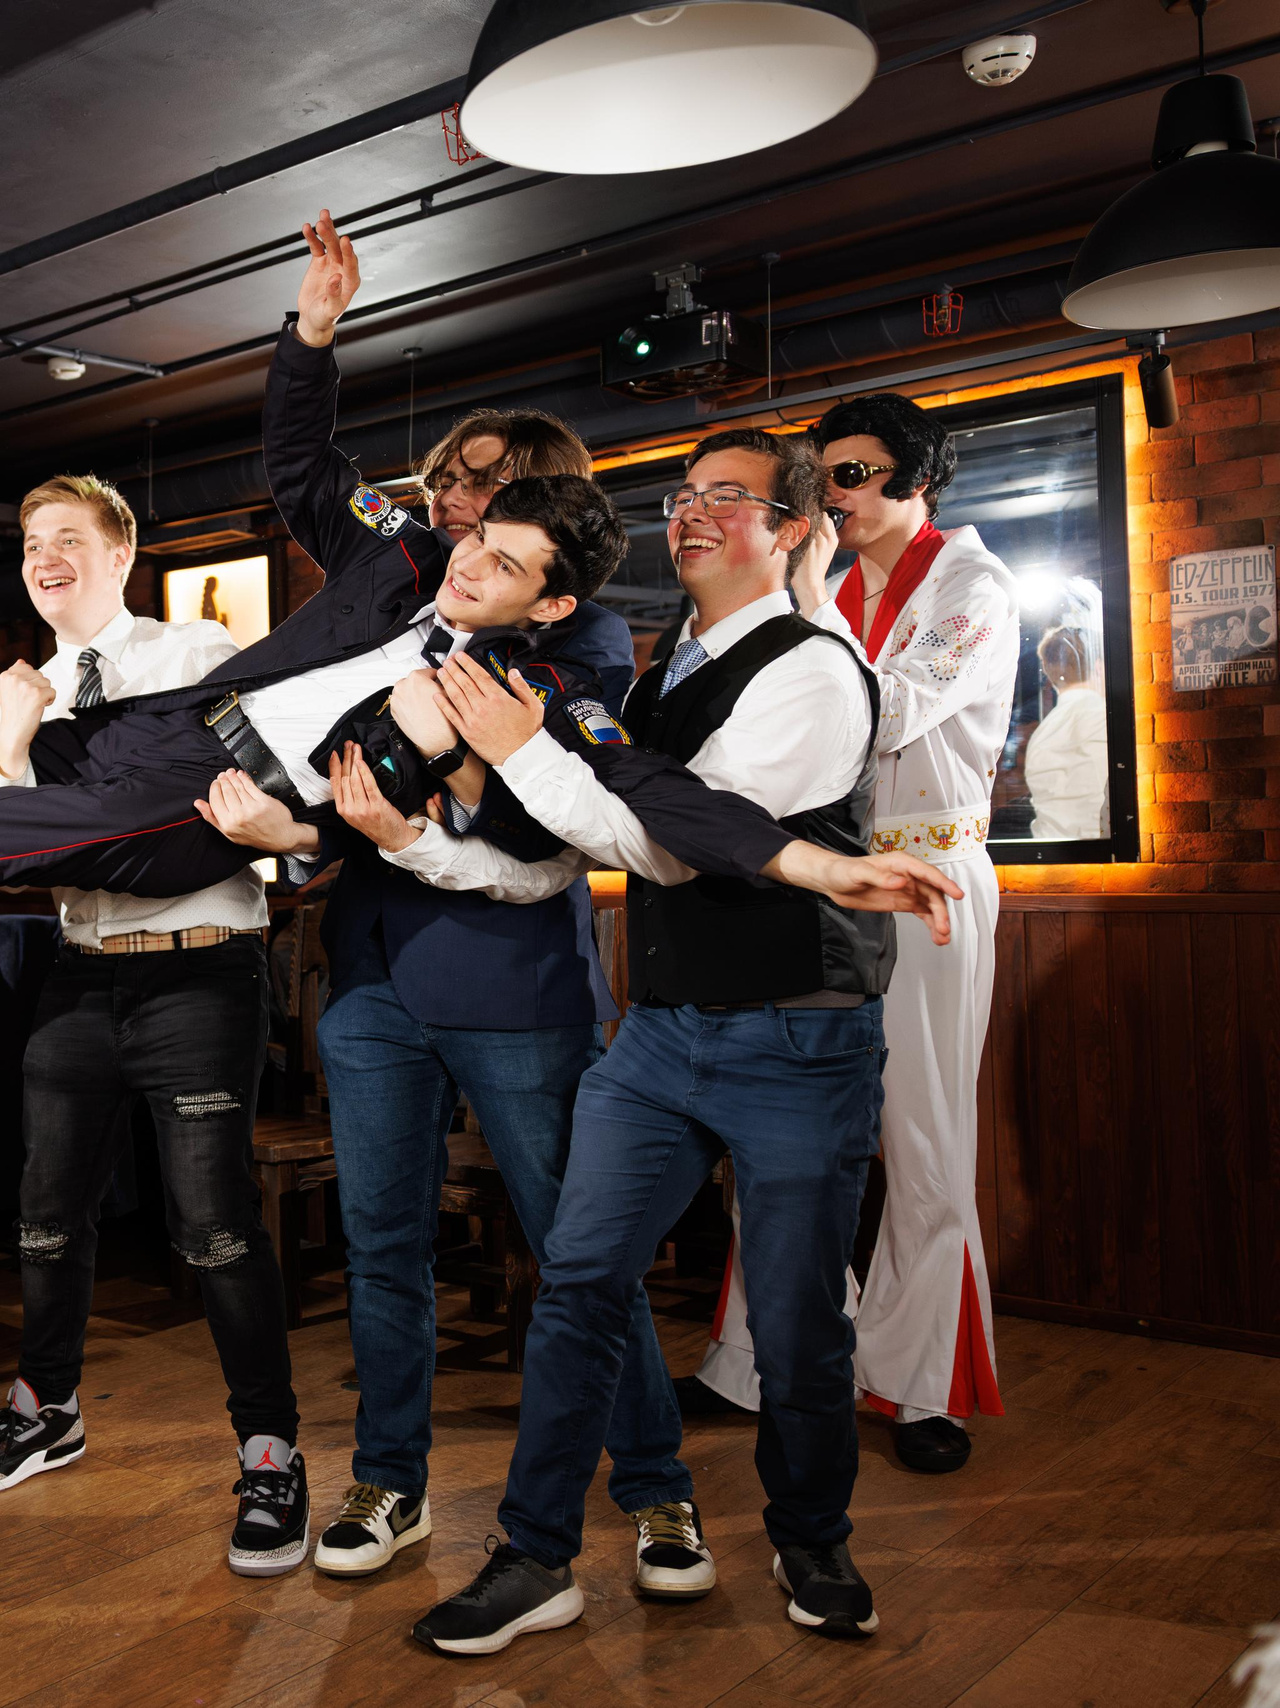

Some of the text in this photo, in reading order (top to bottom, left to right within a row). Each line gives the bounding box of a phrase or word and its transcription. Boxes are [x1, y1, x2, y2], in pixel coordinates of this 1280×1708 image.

[1171, 592, 1198, 605] U.S.
[1201, 587, 1239, 602] TOUR
[1242, 583, 1275, 598] 1977
[1179, 659, 1272, 675] APRIL 25 FREEDOM HALL
[1256, 669, 1276, 685] KY
